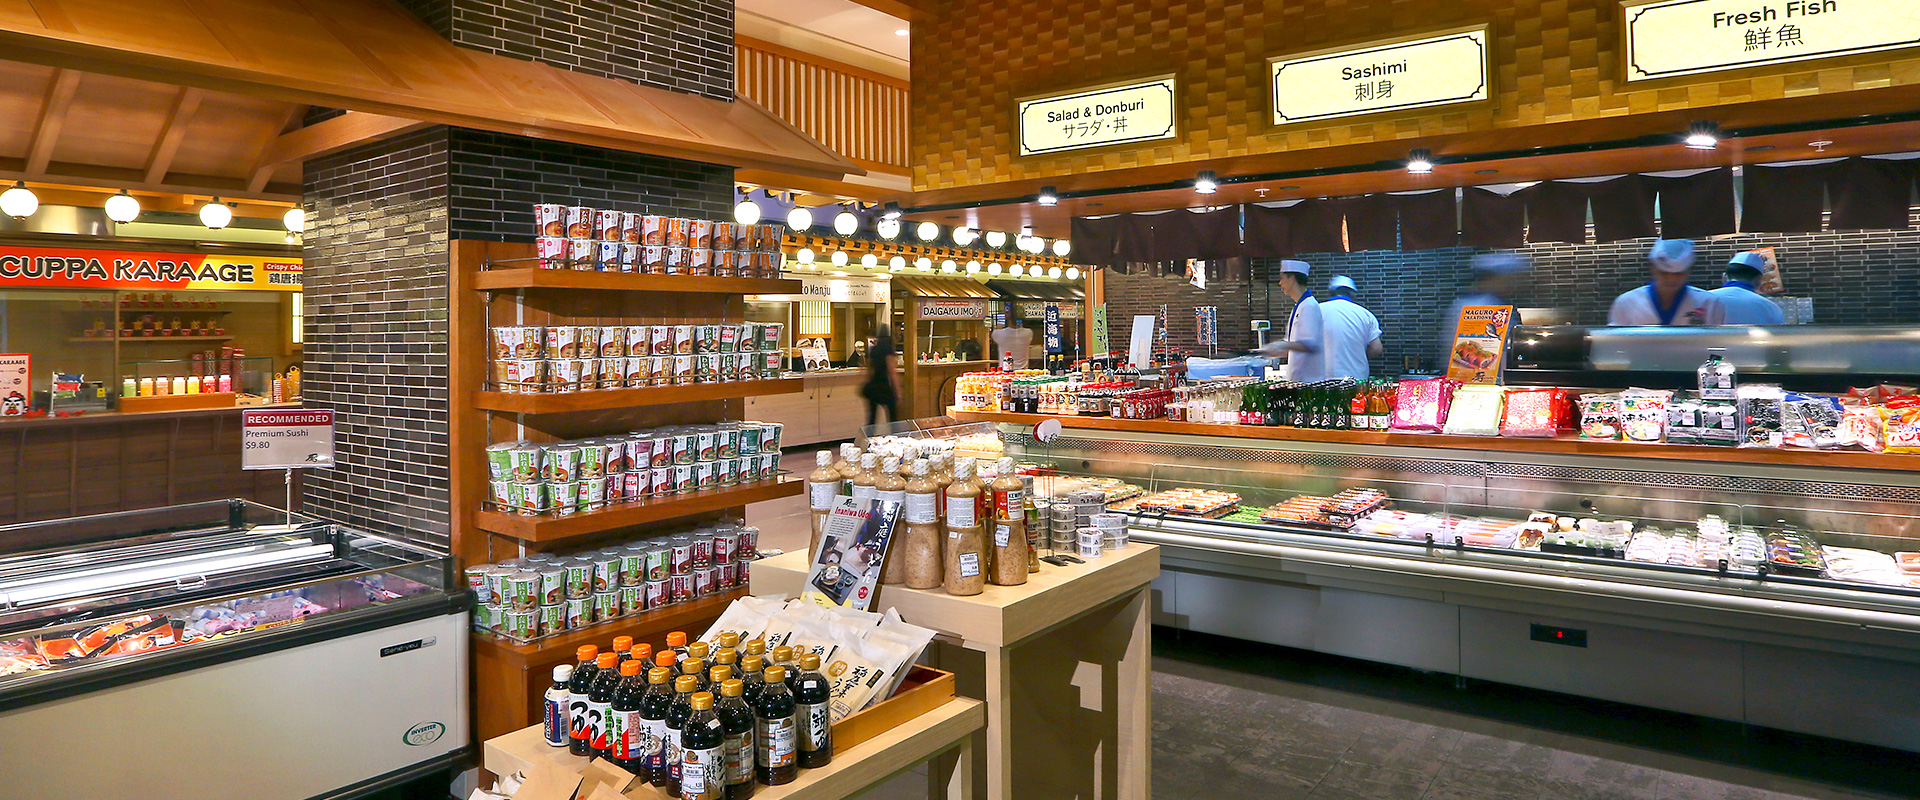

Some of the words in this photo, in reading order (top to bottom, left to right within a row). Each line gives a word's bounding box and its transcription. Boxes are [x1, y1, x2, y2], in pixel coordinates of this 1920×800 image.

[1713, 5, 1776, 28] Fresh
[1786, 0, 1837, 18] Fish
[1744, 24, 1804, 52] 鮮魚
[1341, 59, 1407, 81] Sashimi
[1354, 79, 1395, 102] 刺身
[1047, 107, 1080, 123] Salad
[1083, 106, 1092, 118] &
[1095, 98, 1144, 117] Donburi
[1062, 115, 1128, 139] サラダ・丼
[0, 255, 107, 280] CUPPA
[114, 259, 255, 283] KARAAGE
[266, 263, 288, 271] Crispy
[923, 307, 960, 316] DAIGAKU
[960, 307, 974, 316] IMO
[247, 414, 329, 424] RECOMMENDED
[245, 429, 285, 438] Premium
[286, 428, 309, 437] Sushi
[245, 441, 270, 450] $9.80
[834, 506, 858, 517] Inaniwa
[857, 508, 873, 519] Udon
[570, 701, 589, 736] つゆ
[411, 723, 437, 736] INVERTER
[412, 730, 435, 744] eco
